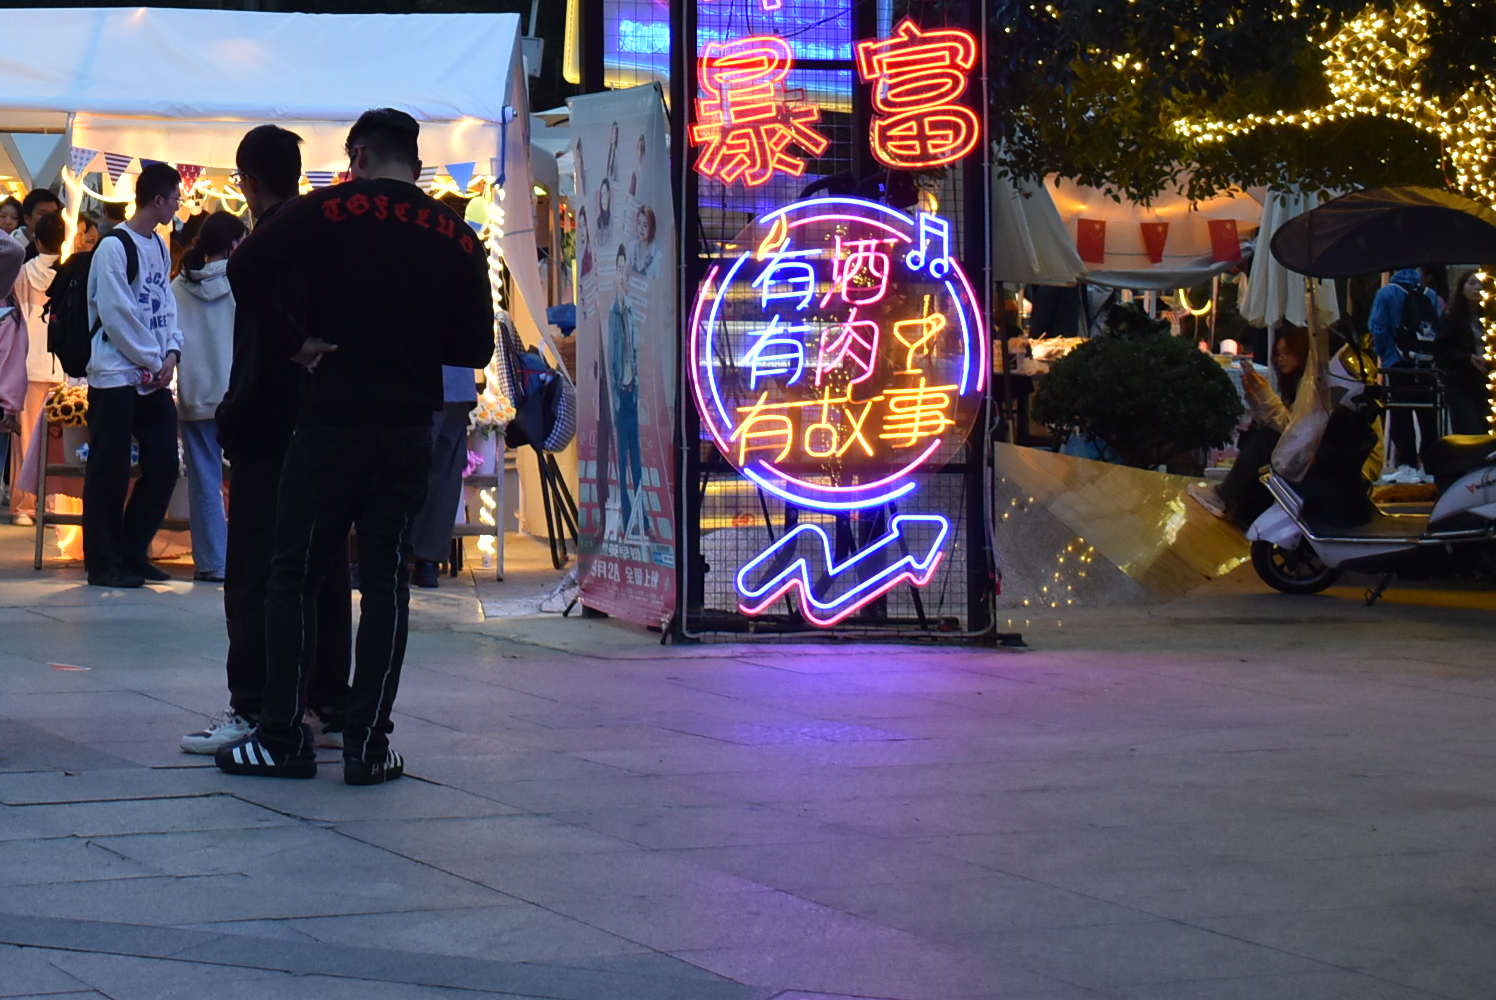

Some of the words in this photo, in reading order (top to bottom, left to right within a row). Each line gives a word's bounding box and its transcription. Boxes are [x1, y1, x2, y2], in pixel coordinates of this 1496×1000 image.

[688, 20, 981, 188] 暴富
[751, 234, 900, 311] 有酒
[743, 306, 882, 390] 有肉
[729, 376, 959, 467] 有故事
